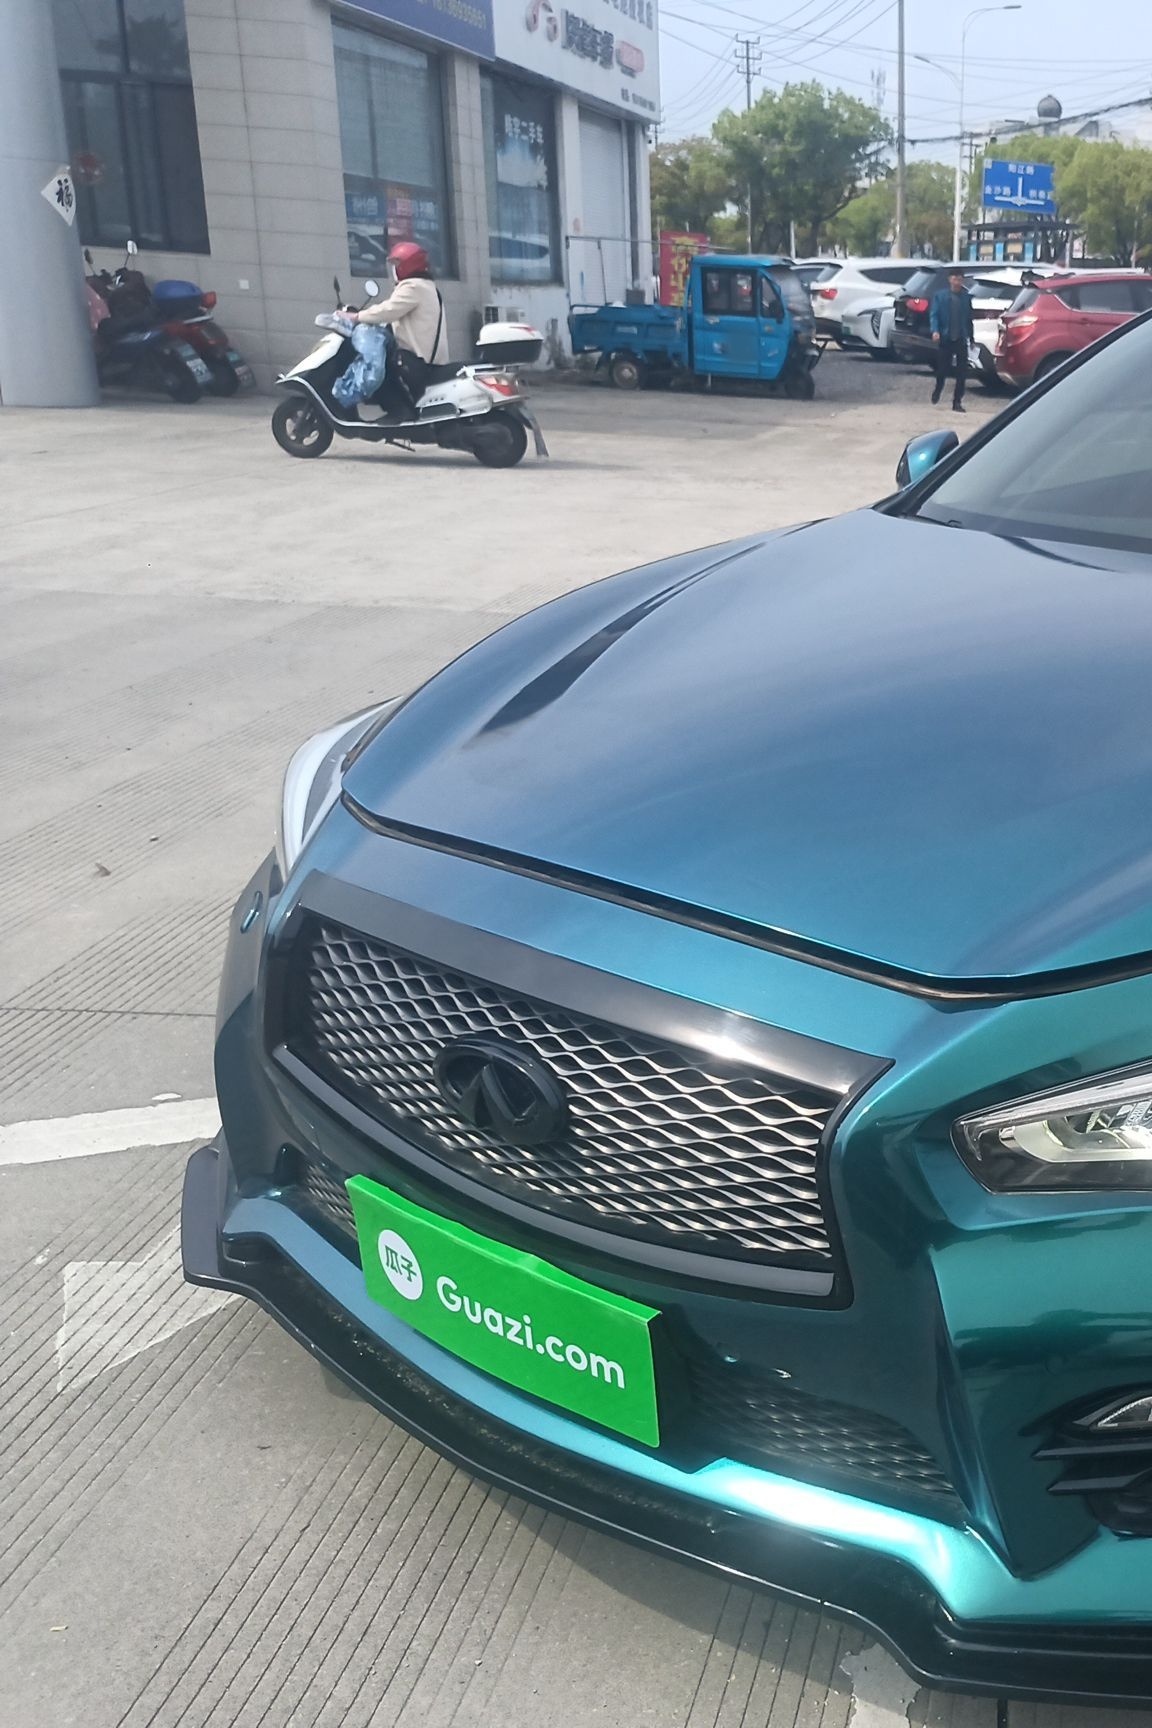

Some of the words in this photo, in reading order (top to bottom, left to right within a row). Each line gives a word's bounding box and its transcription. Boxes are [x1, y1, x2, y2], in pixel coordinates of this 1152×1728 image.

[55, 177, 72, 210] 福
[384, 1244, 418, 1284] 瓜子
[436, 1275, 625, 1389] Guazi.com
